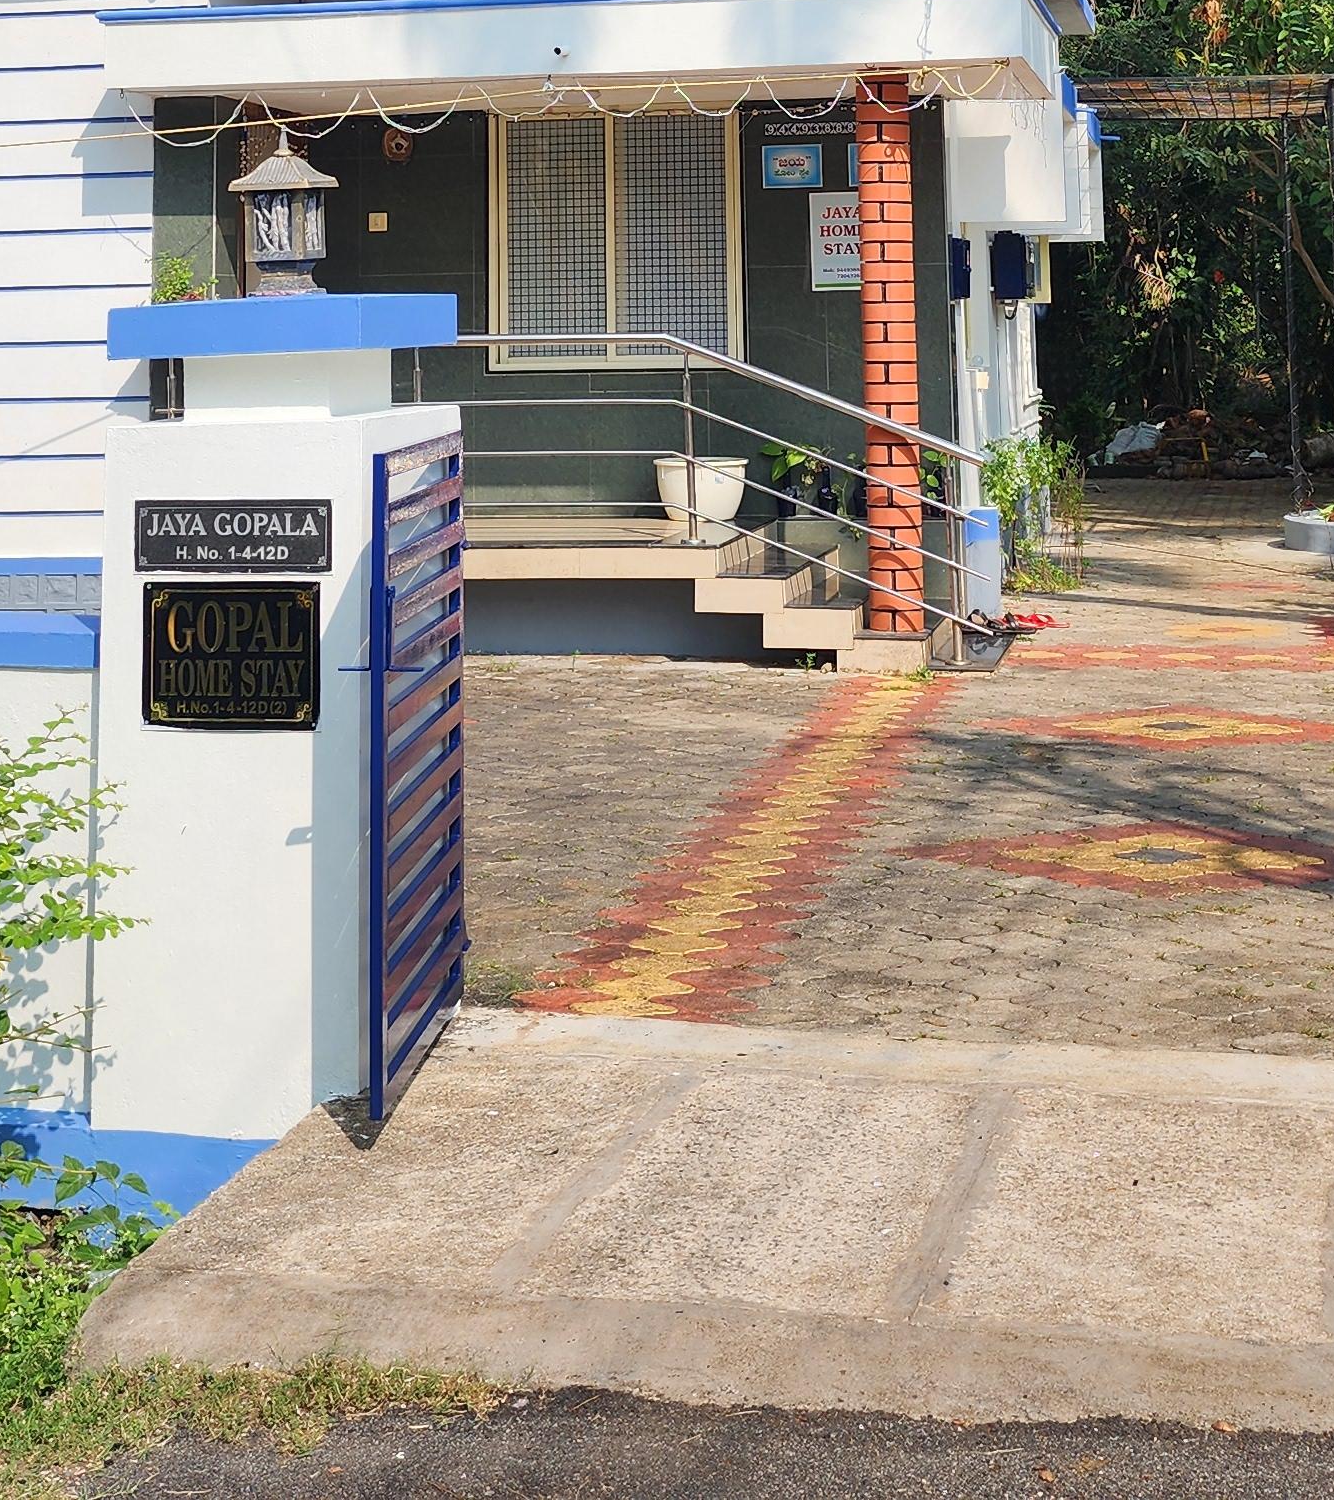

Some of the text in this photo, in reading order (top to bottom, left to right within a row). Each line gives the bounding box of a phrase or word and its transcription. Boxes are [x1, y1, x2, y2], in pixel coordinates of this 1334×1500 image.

[766, 122, 856, 135] 94493888
[819, 224, 860, 237] HOM
[146, 512, 320, 536] JAYA GOPALA
[196, 546, 223, 560] No.
[227, 546, 289, 560] 1-4-12D
[167, 600, 304, 654] GOPAL
[158, 659, 306, 698] HOME STAY
